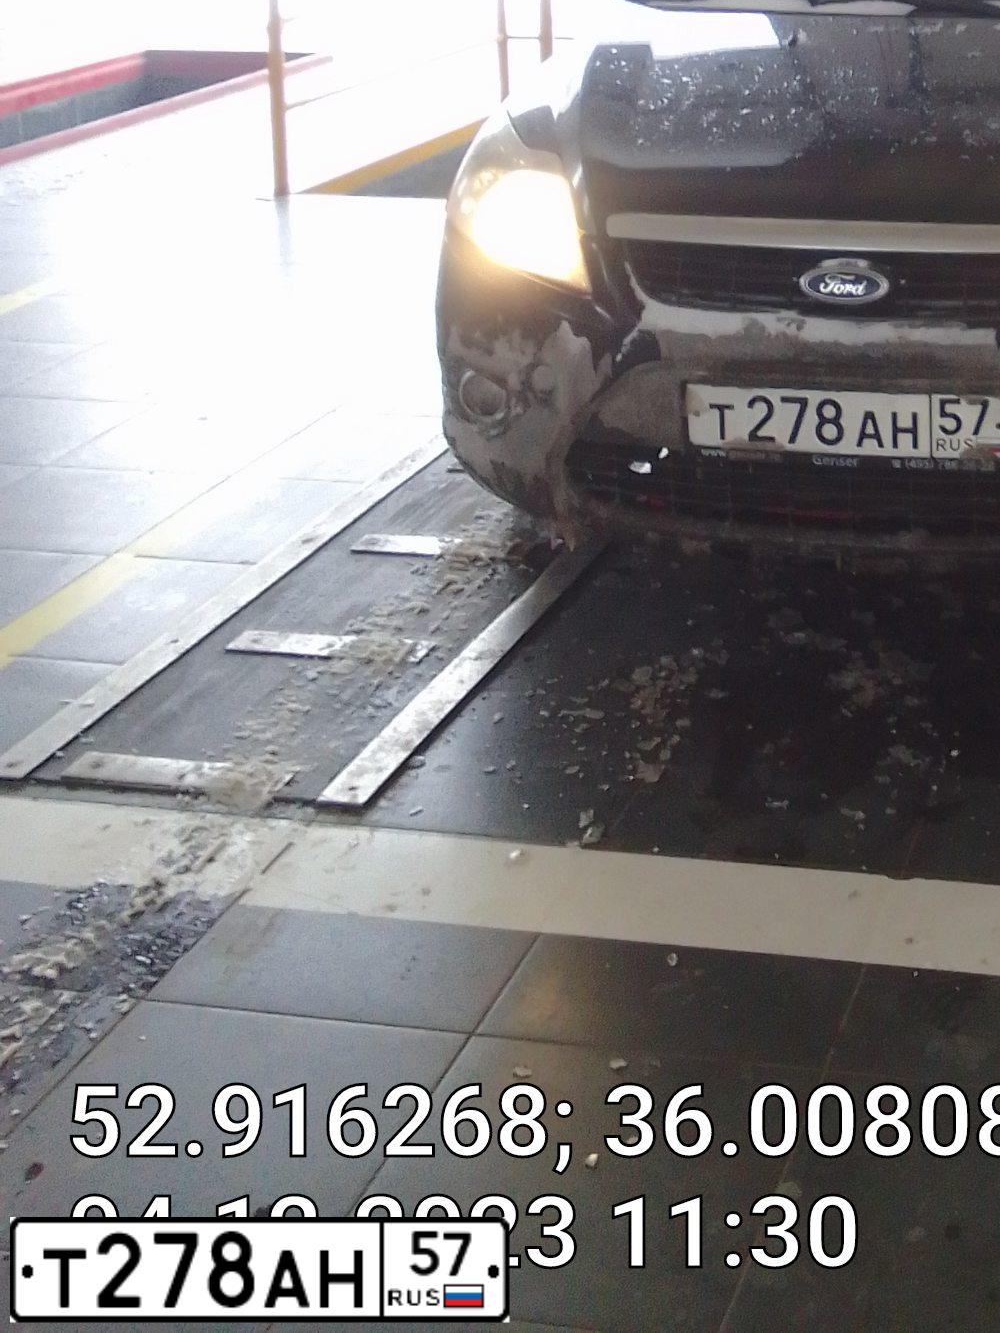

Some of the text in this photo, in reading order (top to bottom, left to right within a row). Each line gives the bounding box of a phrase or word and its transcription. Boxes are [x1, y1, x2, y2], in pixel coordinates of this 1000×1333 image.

[819, 273, 868, 297] Ford
[938, 397, 990, 436] 57
[935, 437, 974, 453] RUS
